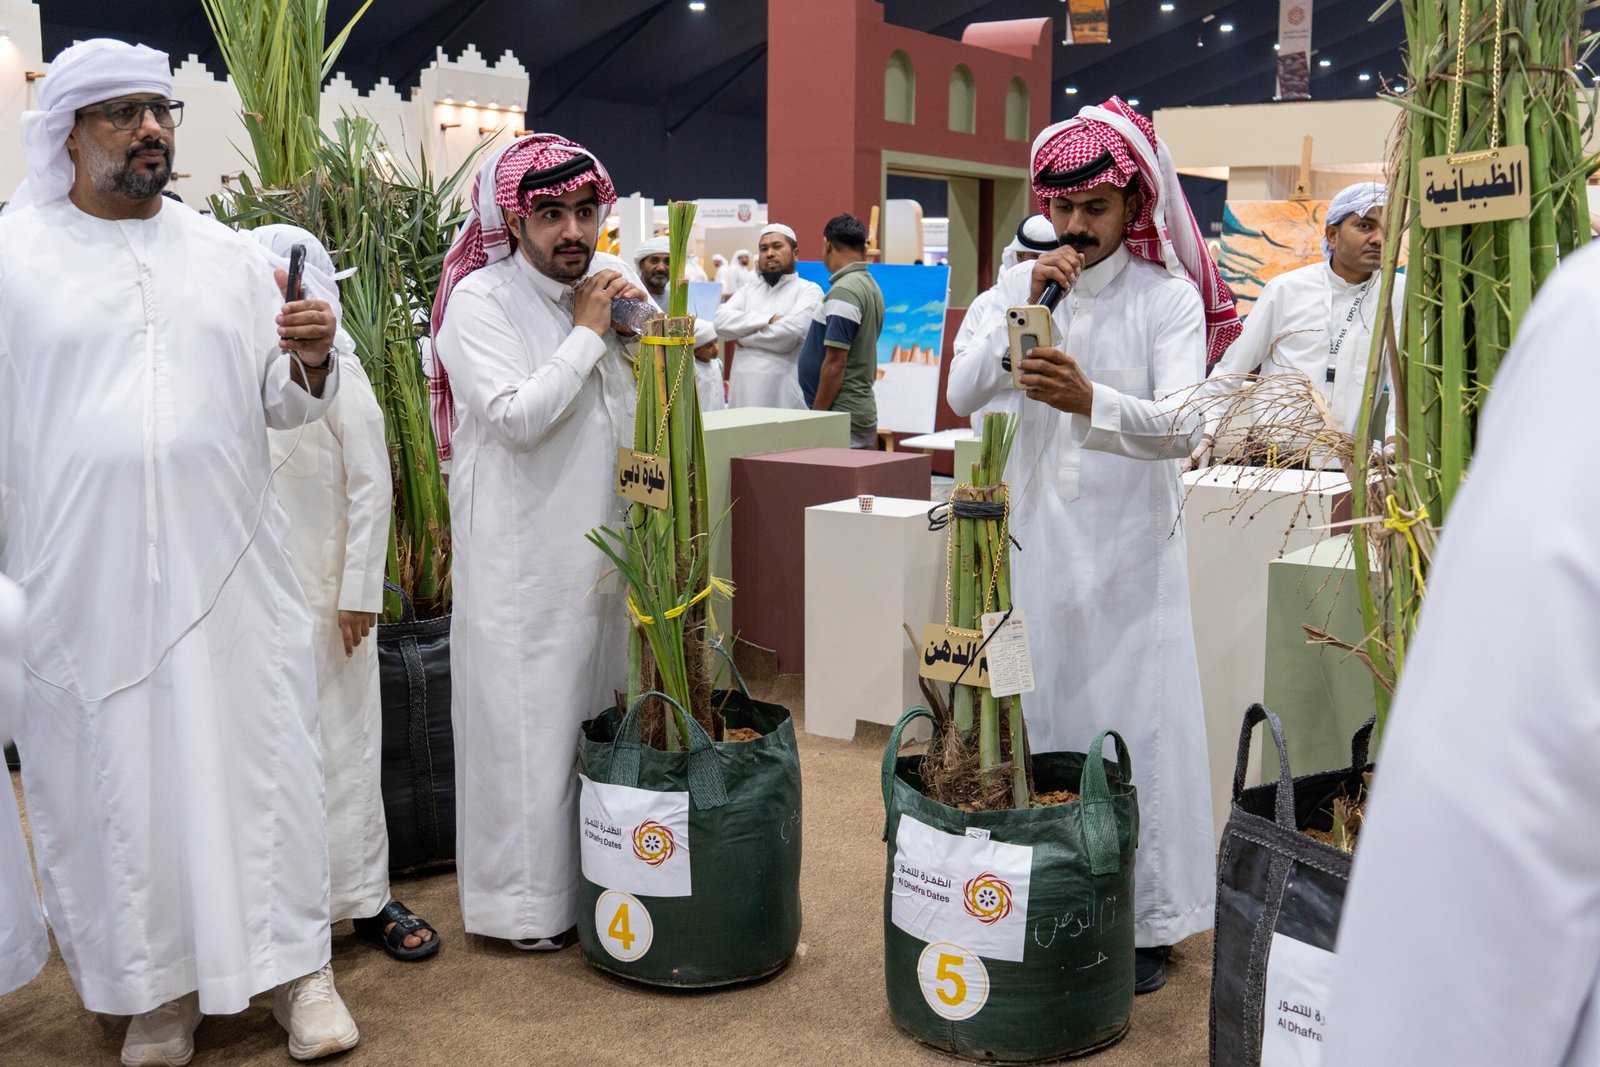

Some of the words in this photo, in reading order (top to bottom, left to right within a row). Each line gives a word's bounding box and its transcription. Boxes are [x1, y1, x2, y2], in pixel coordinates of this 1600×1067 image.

[1426, 160, 1522, 212] الظبيانية
[1346, 306, 1357, 322] EXPO
[1353, 296, 1361, 308] 965
[620, 463, 640, 493] دبي
[924, 640, 977, 668] الدهن
[600, 822, 622, 837] الظفرة
[603, 838, 622, 850] Dates
[899, 863, 919, 878] للتمور
[920, 871, 952, 889] الظفرة
[904, 879, 925, 896] Dhafra
[926, 889, 950, 904] Dates
[608, 902, 635, 951] 4
[936, 952, 967, 1007] 5
[1278, 1000, 1312, 1018] للتمور
[1277, 1017, 1287, 1029] Al
[1287, 1020, 1323, 1042] Dhafra
